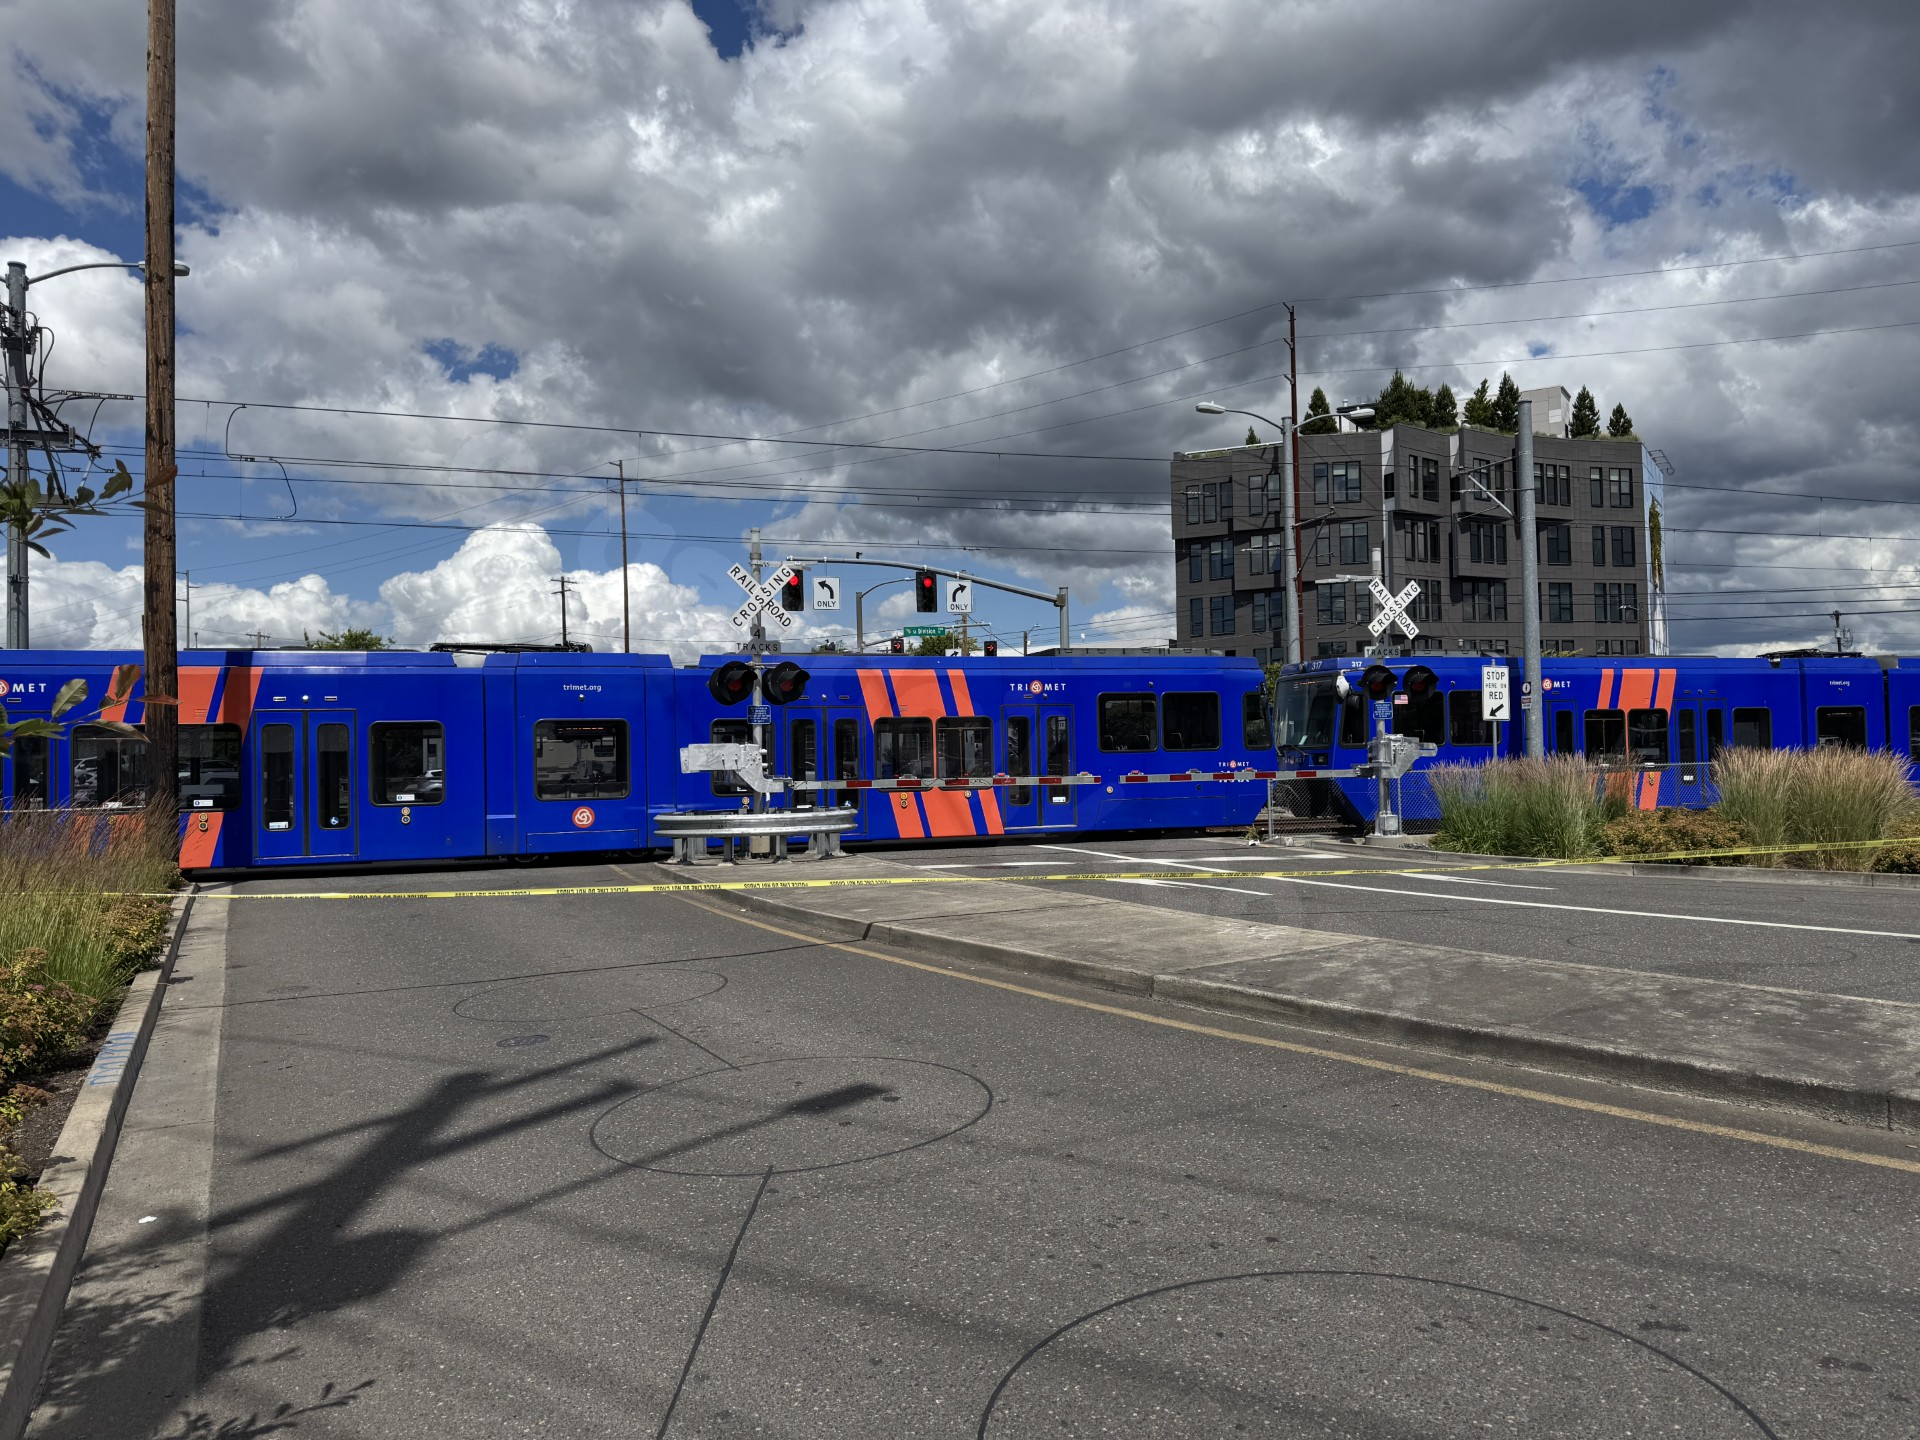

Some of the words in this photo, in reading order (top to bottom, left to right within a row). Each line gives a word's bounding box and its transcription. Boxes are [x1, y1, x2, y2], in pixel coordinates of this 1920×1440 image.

[732, 567, 791, 627] CROSSING
[1372, 584, 1418, 633] CROSSING
[754, 629, 760, 638] 4
[1487, 672, 1505, 680] STOP
[12, 683, 46, 692] MET
[563, 684, 602, 692] trimet.org
